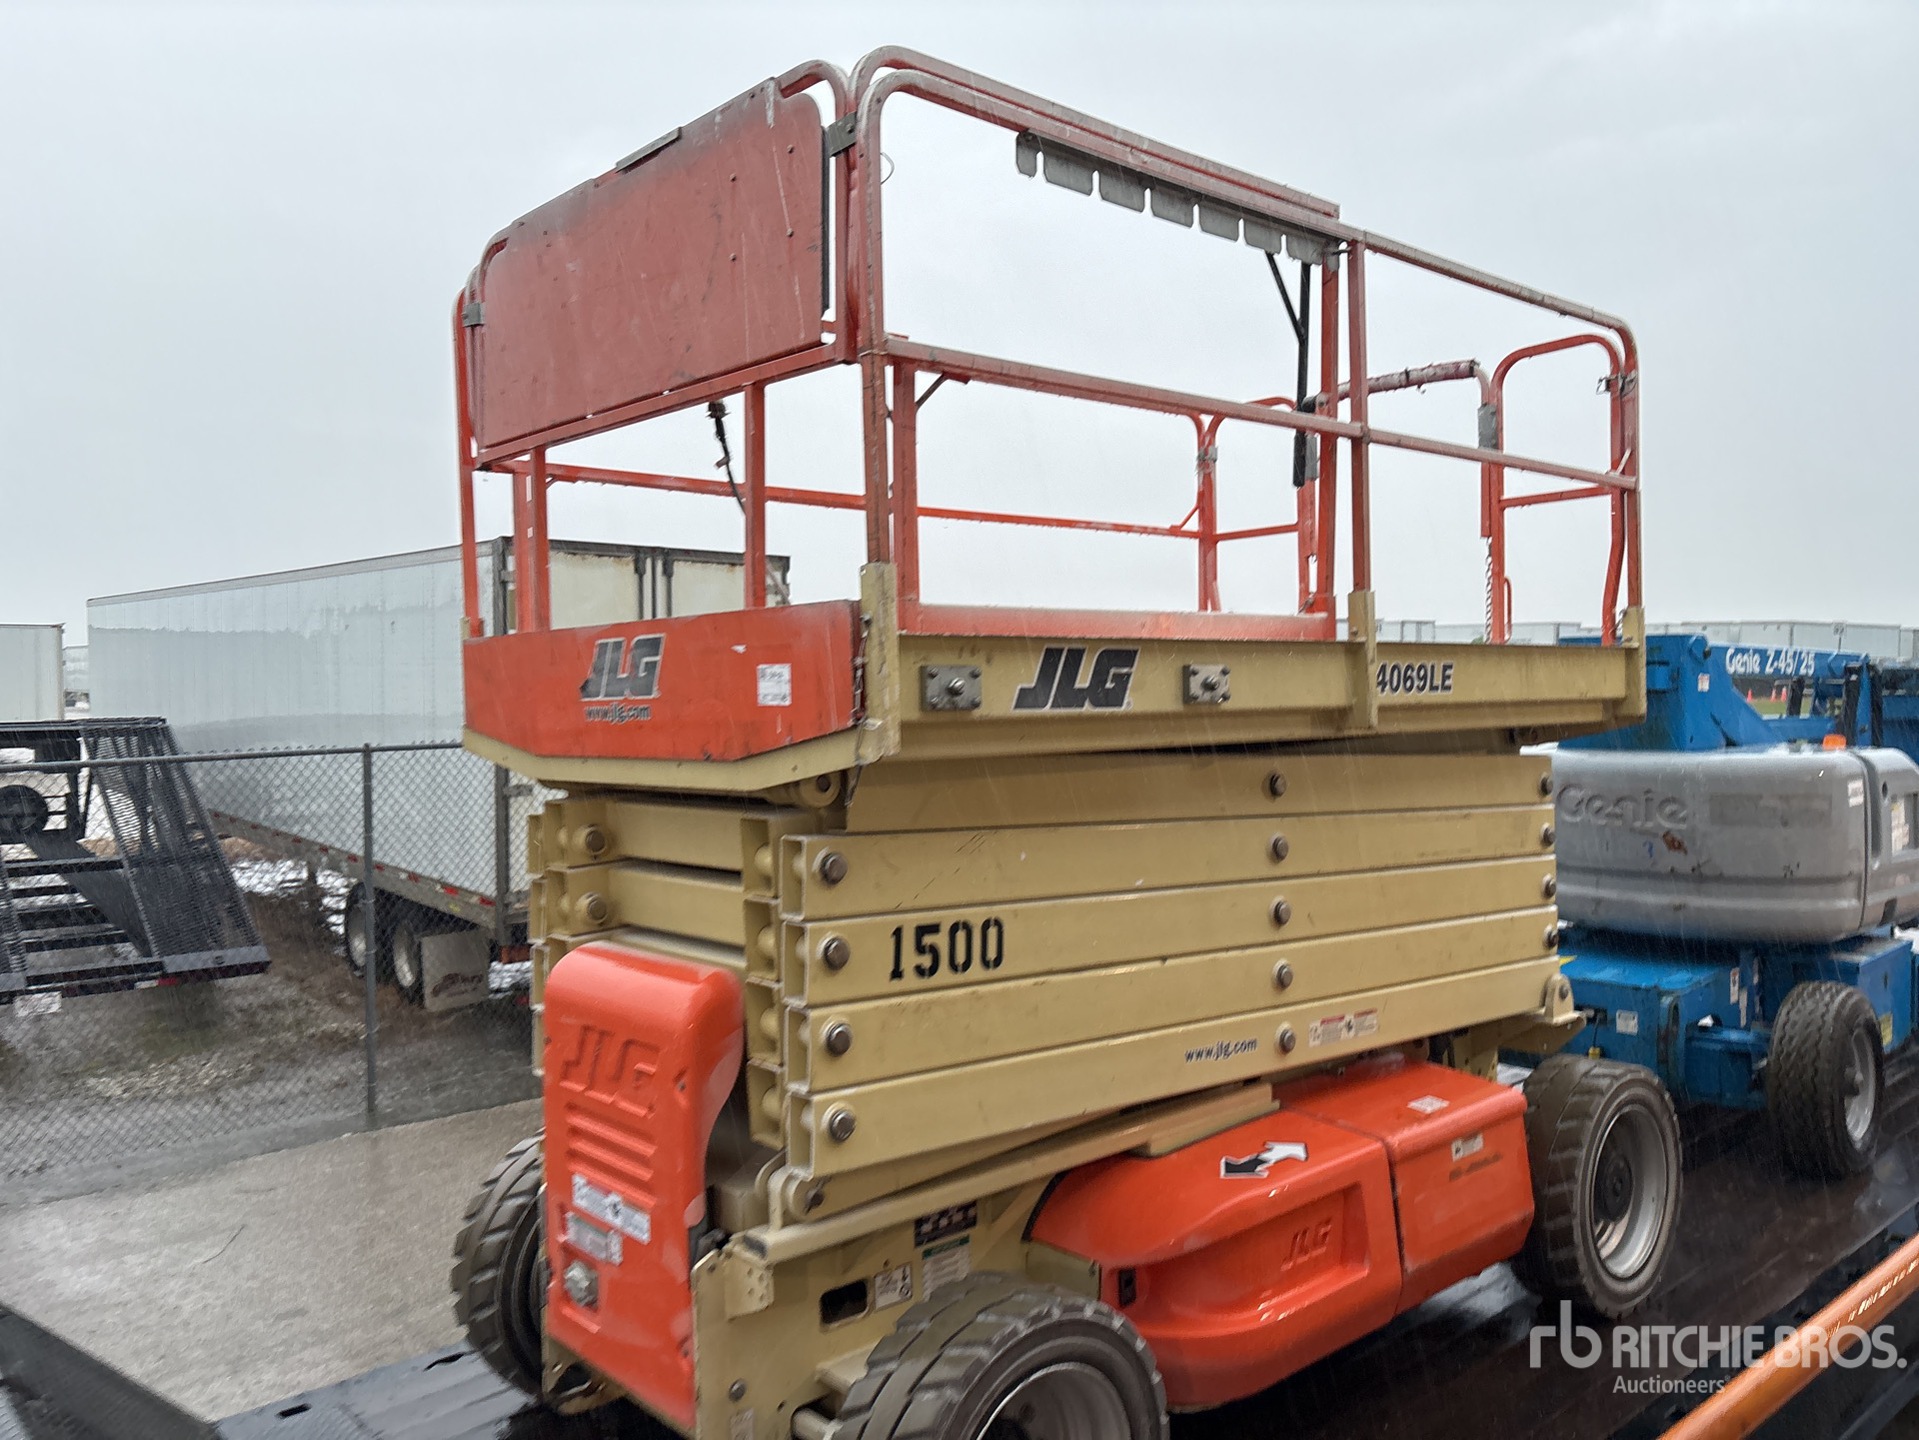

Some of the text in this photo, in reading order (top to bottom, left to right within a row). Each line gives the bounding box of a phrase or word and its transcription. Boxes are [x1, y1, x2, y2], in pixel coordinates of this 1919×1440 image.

[579, 634, 665, 702] JLG
[1013, 646, 1139, 710] JLG
[1376, 661, 1453, 694] 4069LE
[1726, 646, 1761, 675] Genie
[890, 917, 1004, 980] 1500
[1184, 1038, 1258, 1064] www.jlg.com
